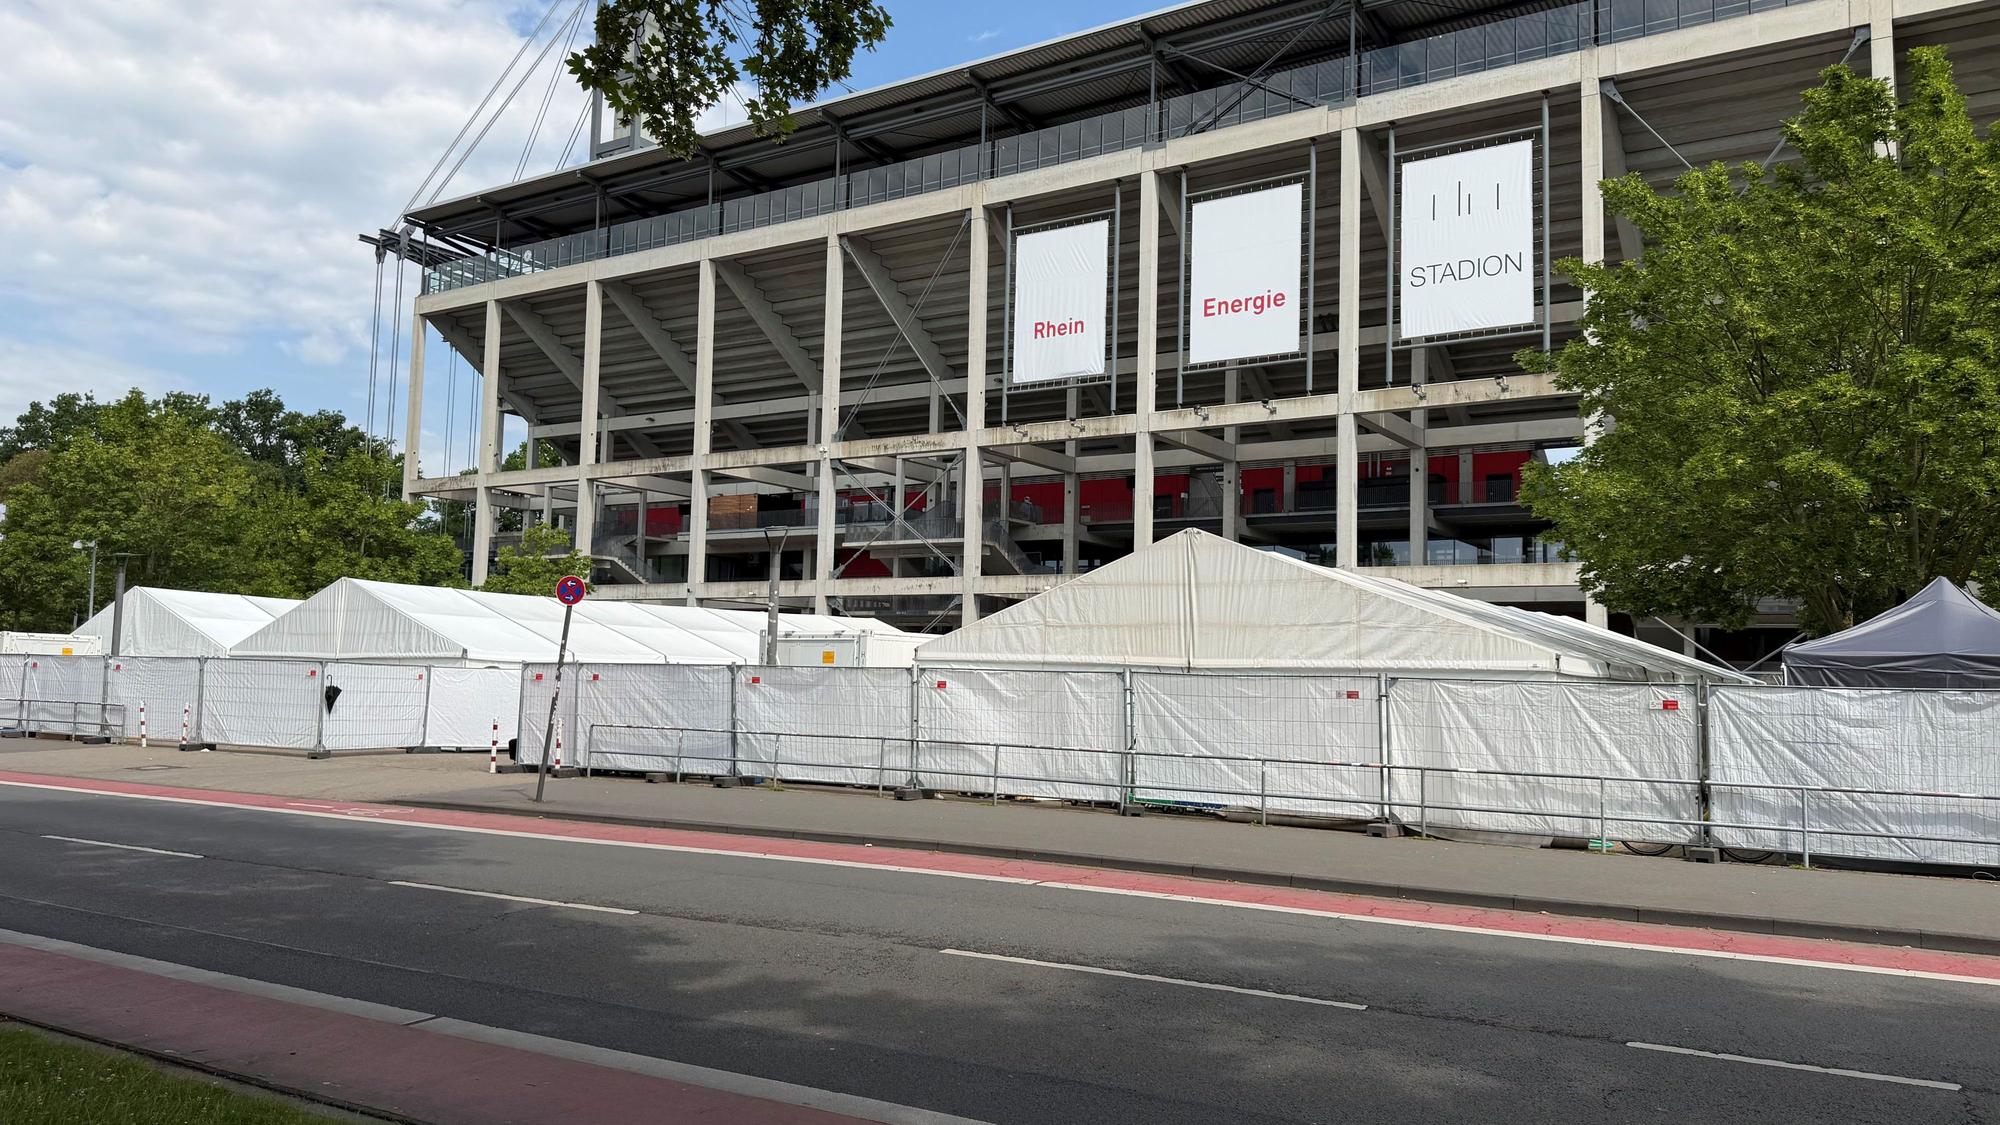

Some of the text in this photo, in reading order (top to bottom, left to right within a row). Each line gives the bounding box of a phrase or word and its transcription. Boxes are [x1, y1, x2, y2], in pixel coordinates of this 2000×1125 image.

[1410, 251, 1523, 288] STADION
[1203, 289, 1286, 318] Energie
[1033, 317, 1085, 339] Rhein
